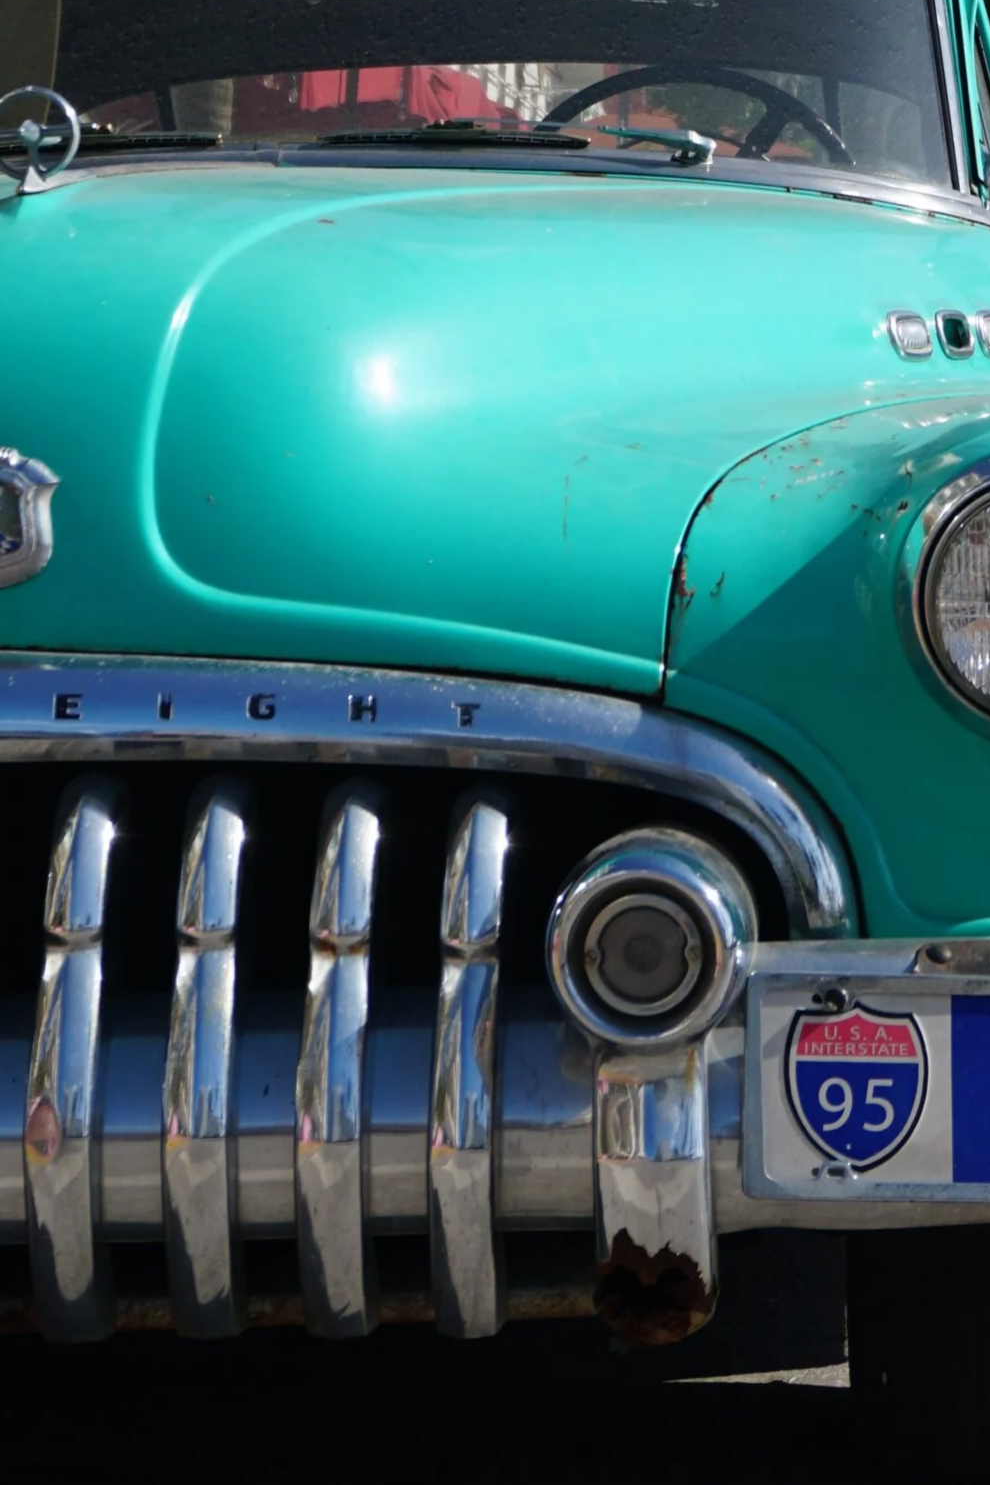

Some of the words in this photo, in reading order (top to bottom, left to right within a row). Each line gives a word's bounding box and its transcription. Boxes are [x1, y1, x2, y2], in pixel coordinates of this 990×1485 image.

[53, 692, 480, 728] EIGHT
[804, 1042, 908, 1055] INTERSTATE
[818, 1077, 894, 1132] 95
